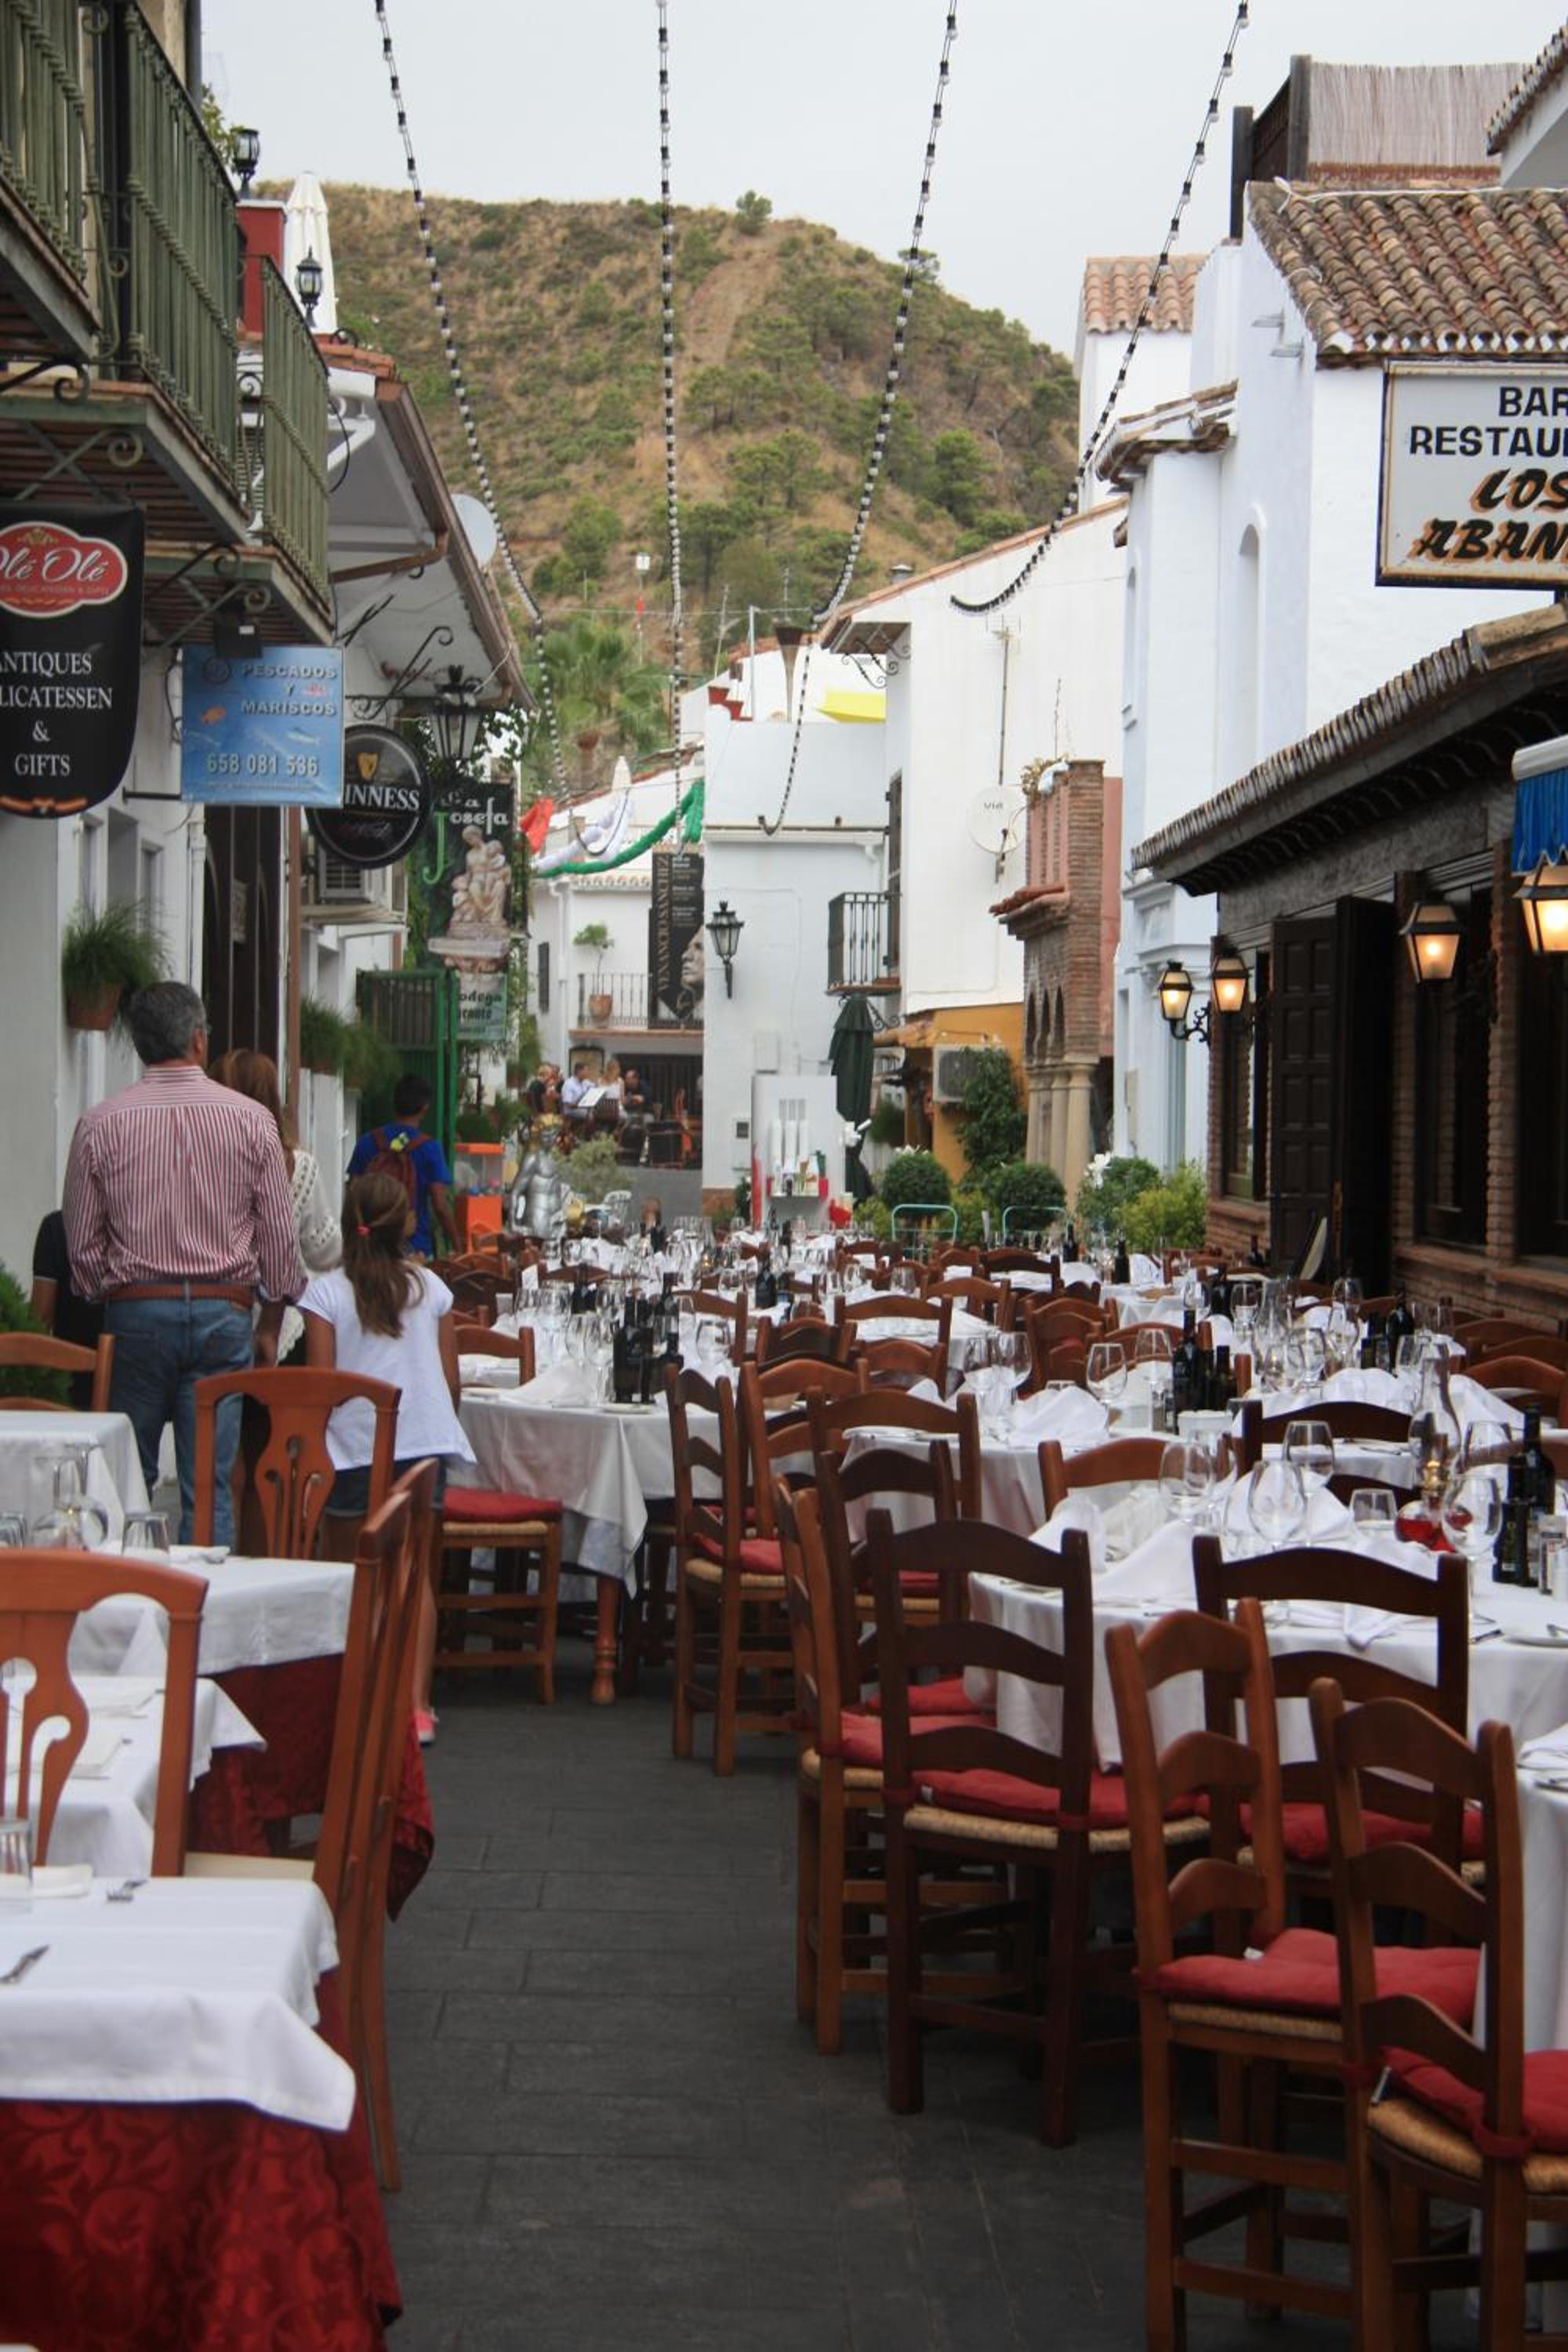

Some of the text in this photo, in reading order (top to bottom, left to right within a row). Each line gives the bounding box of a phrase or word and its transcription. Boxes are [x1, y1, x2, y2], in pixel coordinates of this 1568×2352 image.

[1498, 387, 1568, 417] BAR
[1410, 426, 1568, 457] RESTAU
[1469, 467, 1568, 514] LOS
[1407, 517, 1568, 564] ABAN
[0, 547, 109, 583] lé Olé
[0, 652, 93, 677] NTIQUES
[244, 664, 337, 678] PESCADOS
[0, 685, 113, 709] LICATESSEN
[242, 700, 337, 716] MARISCOS
[32, 720, 50, 742] &
[15, 753, 71, 776] GIFTS
[345, 785, 420, 811] INNESS
[459, 990, 503, 1006] odega
